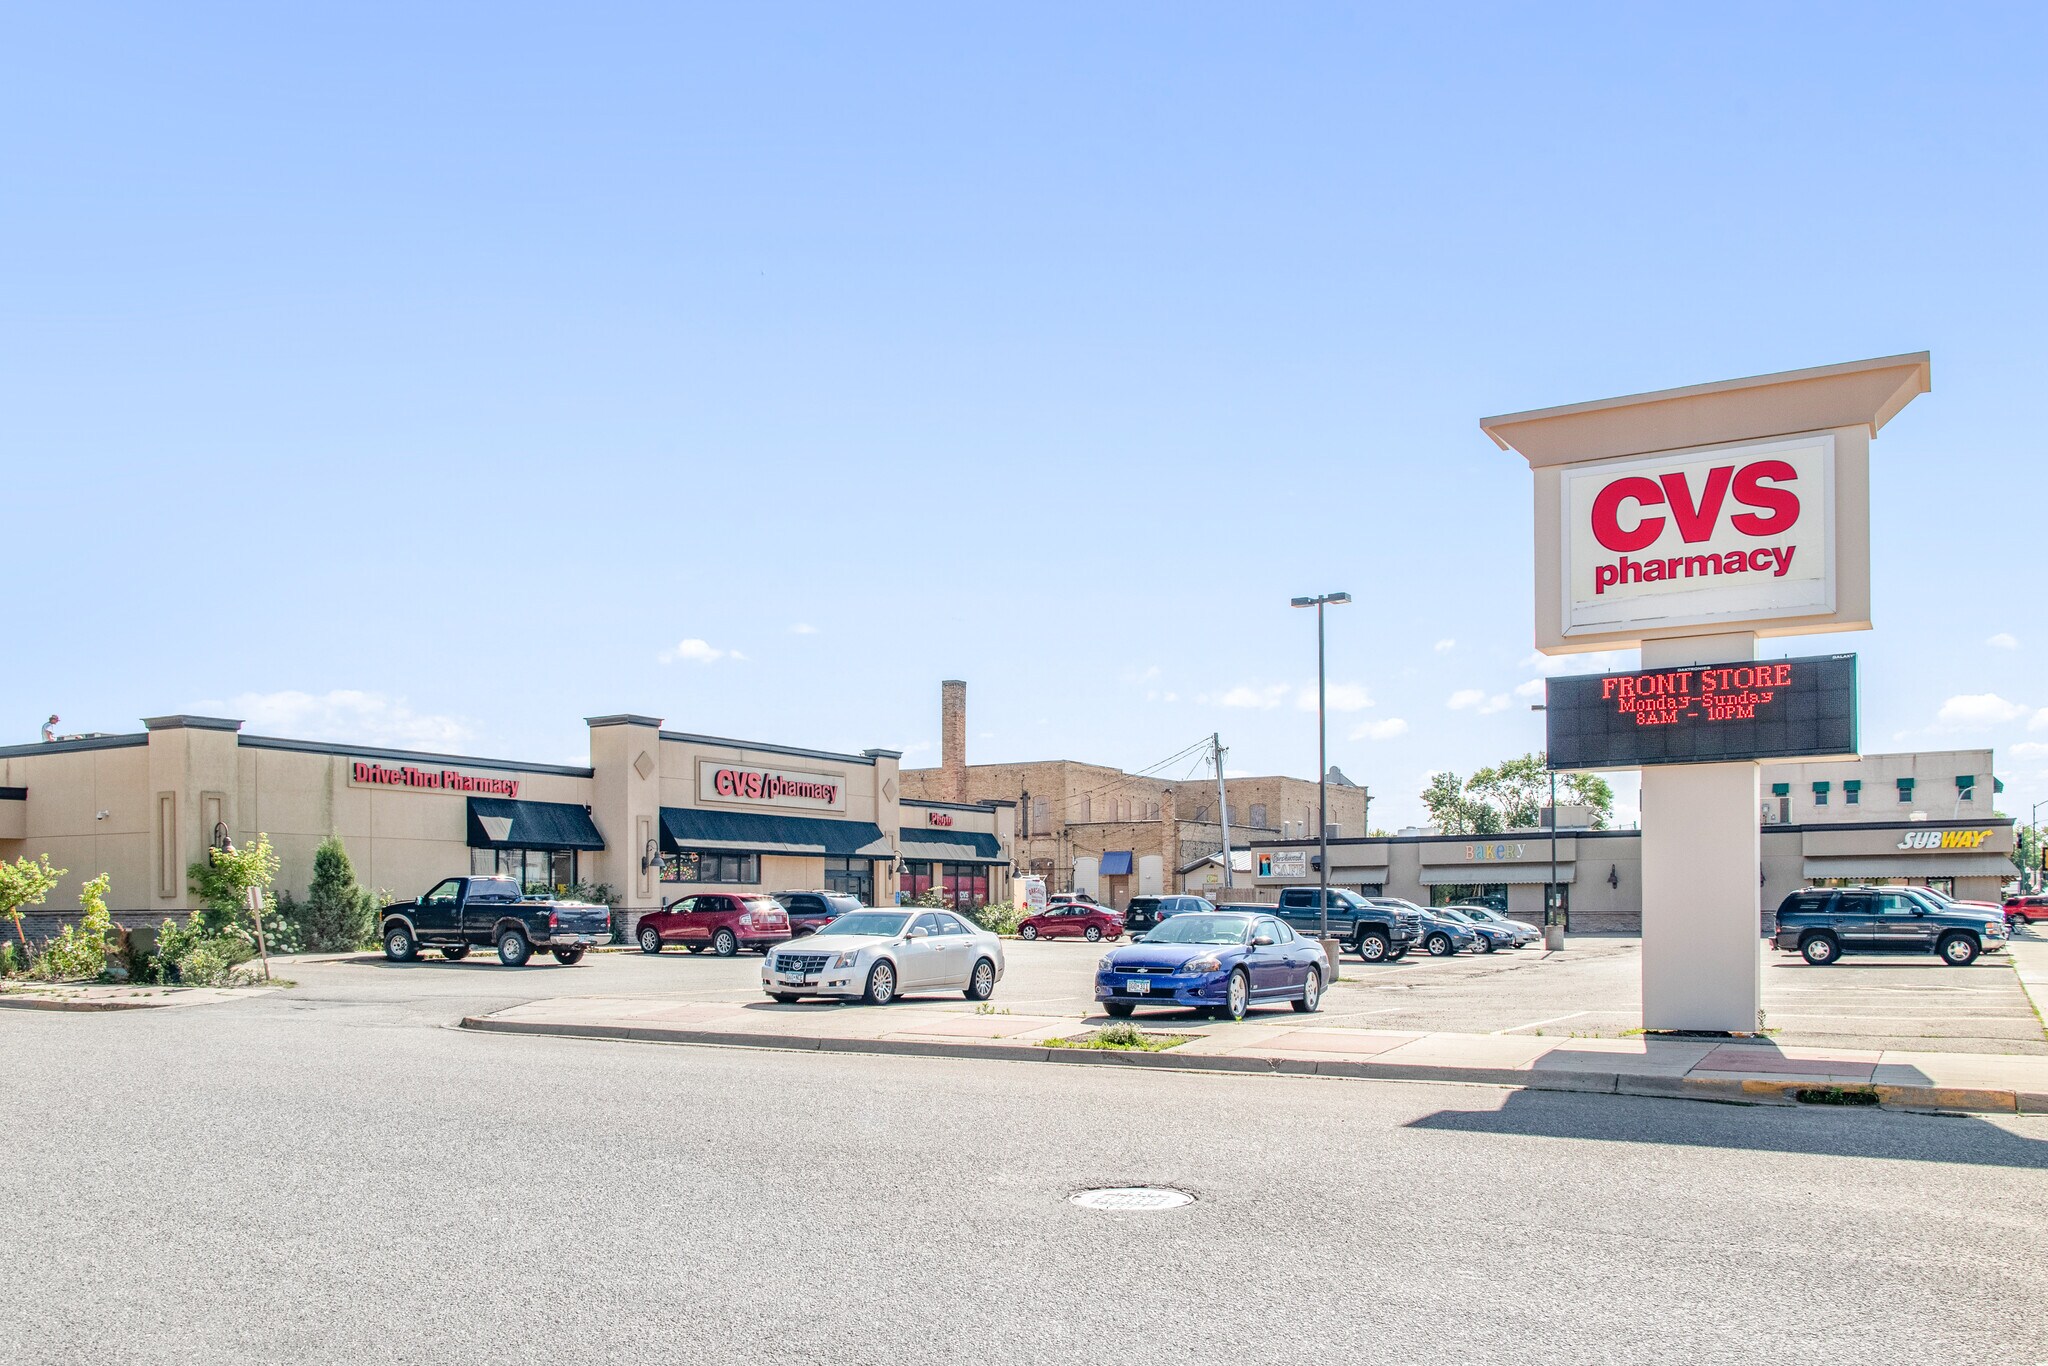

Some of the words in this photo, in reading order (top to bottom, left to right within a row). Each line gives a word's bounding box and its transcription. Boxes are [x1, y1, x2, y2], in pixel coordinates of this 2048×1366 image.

[1591, 460, 1800, 552] CVS
[1595, 545, 1796, 594] pharmacy
[1602, 672, 1693, 699] FRONT
[1702, 664, 1792, 691] STORE
[1618, 691, 1774, 713] Monday-Sunday
[1636, 709, 1678, 725] 8AM
[1708, 704, 1755, 721] 10PM
[354, 762, 440, 788] Drive-Thru
[442, 771, 520, 798] Pharmacy
[929, 812, 953, 826] Photo
[1897, 829, 1994, 850] SUBWAY
